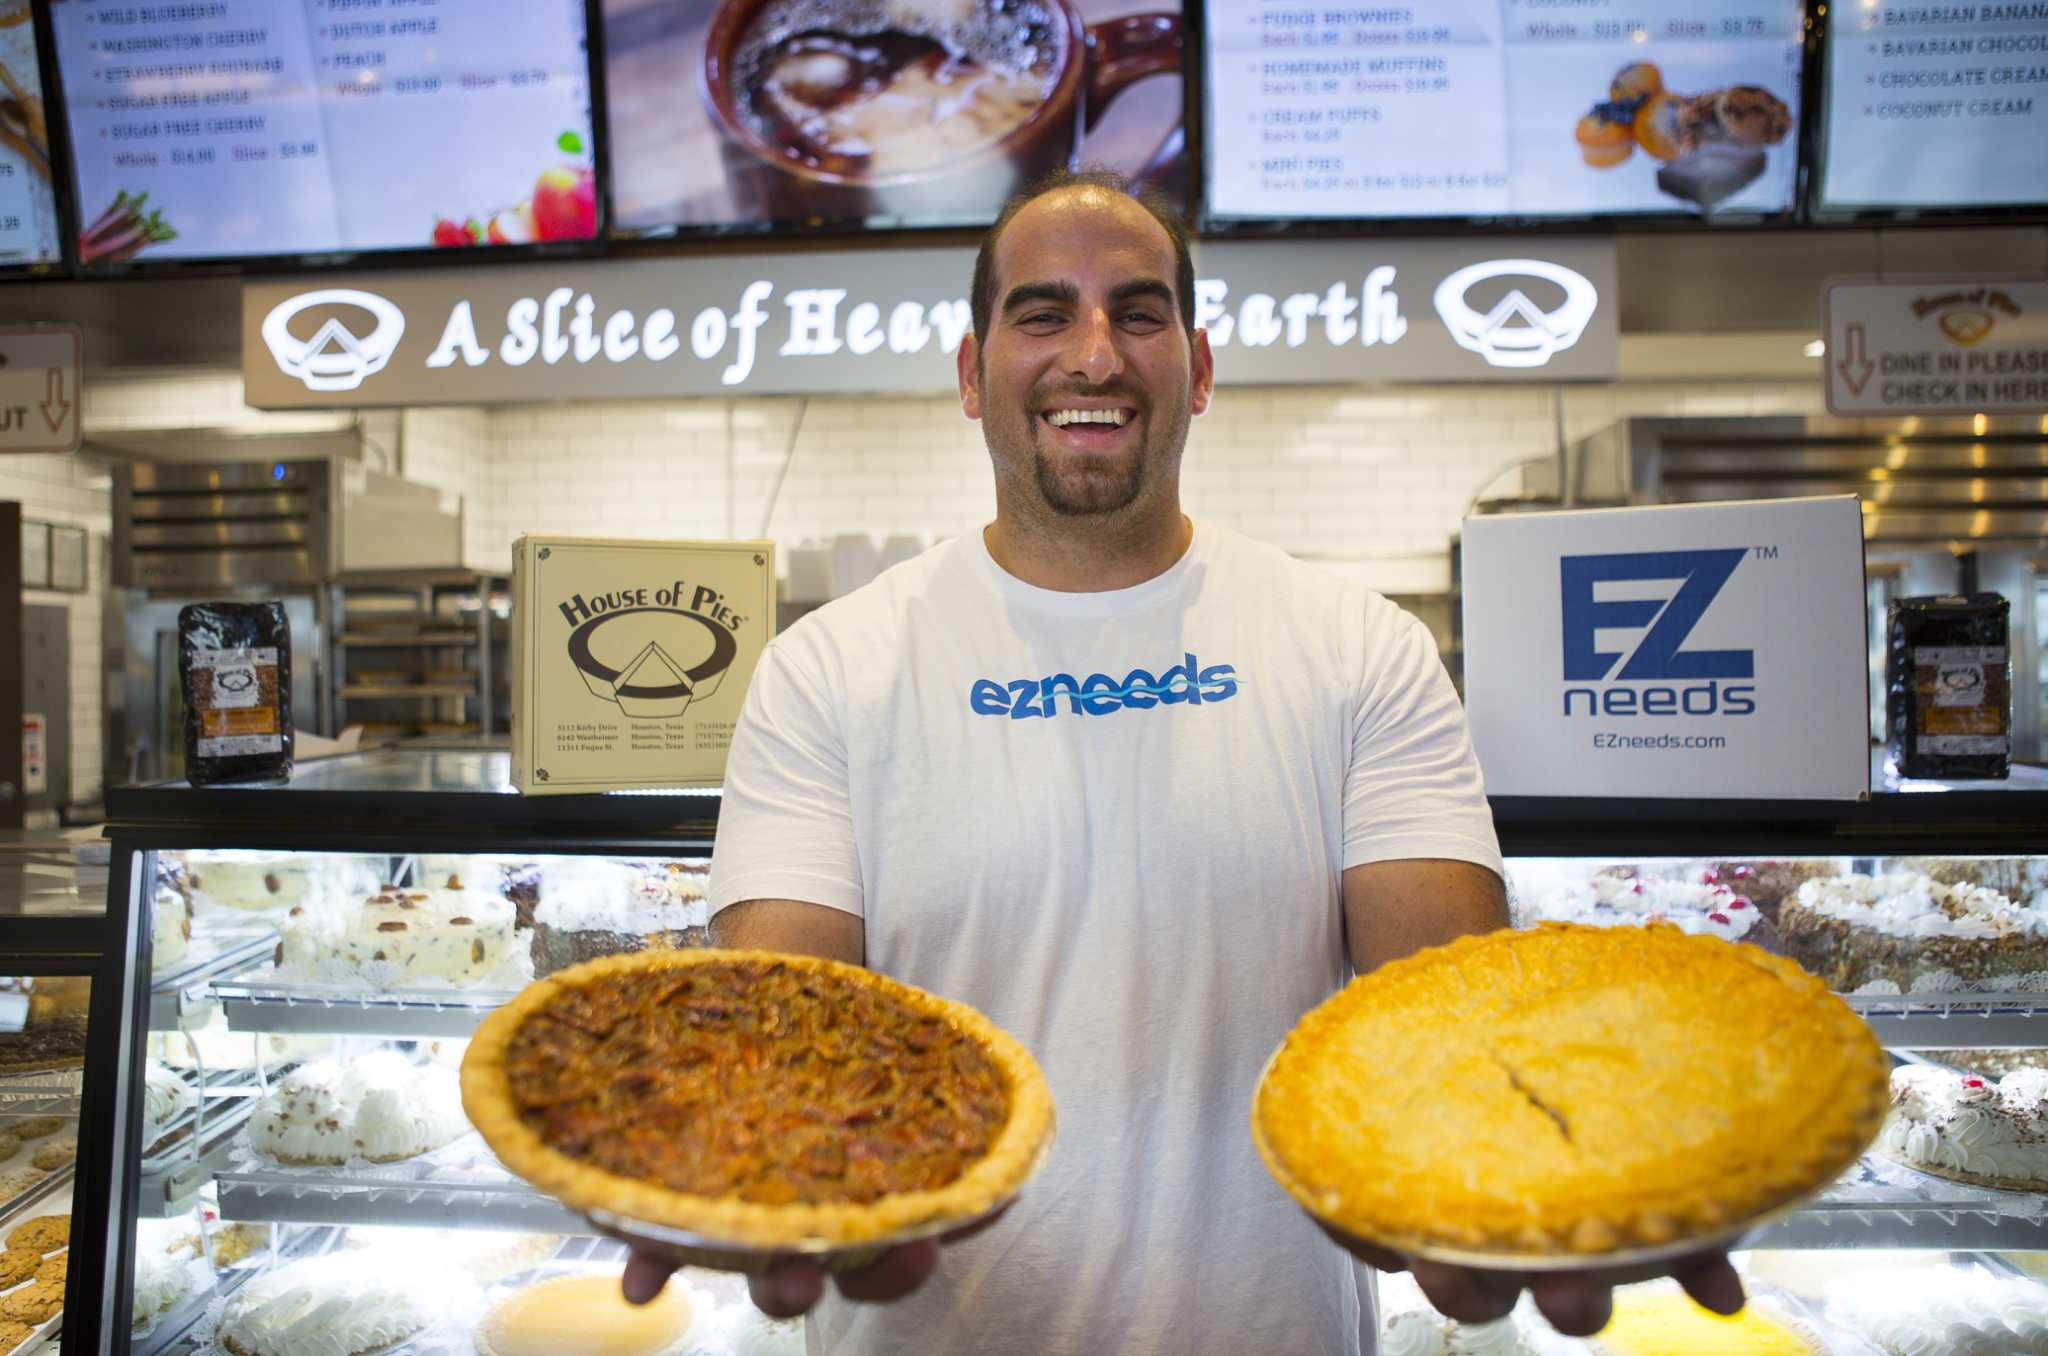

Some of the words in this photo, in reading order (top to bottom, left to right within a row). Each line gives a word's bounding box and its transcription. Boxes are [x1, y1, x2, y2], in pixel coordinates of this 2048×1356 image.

[100, 8, 138, 25] WILD
[140, 3, 228, 23] BLUEBERRY
[1885, 6, 1976, 26] BAVARIAN
[1881, 37, 1974, 58] BAVARIAN
[1878, 67, 1988, 89] CHOCOLATE
[1877, 100, 1963, 121] COCONUT
[1966, 98, 2033, 119] CREAM
[425, 300, 490, 368] A
[499, 286, 681, 367] Slice
[691, 280, 774, 385] of
[1194, 264, 1408, 348] Earth
[1879, 353, 1933, 377] DINE
[1938, 353, 1962, 375] IN
[1880, 379, 1961, 405] CHECK
[1965, 379, 1988, 403] IN
[655, 580, 685, 607] of
[1560, 547, 1755, 681] EZ
[970, 652, 1238, 720] ezneeds
[1563, 681, 1756, 717] needs
[664, 722, 685, 731] Texas
[664, 732, 685, 741] Texas
[664, 740, 685, 750] Texas
[1593, 733, 1726, 749] EZneeds.com
